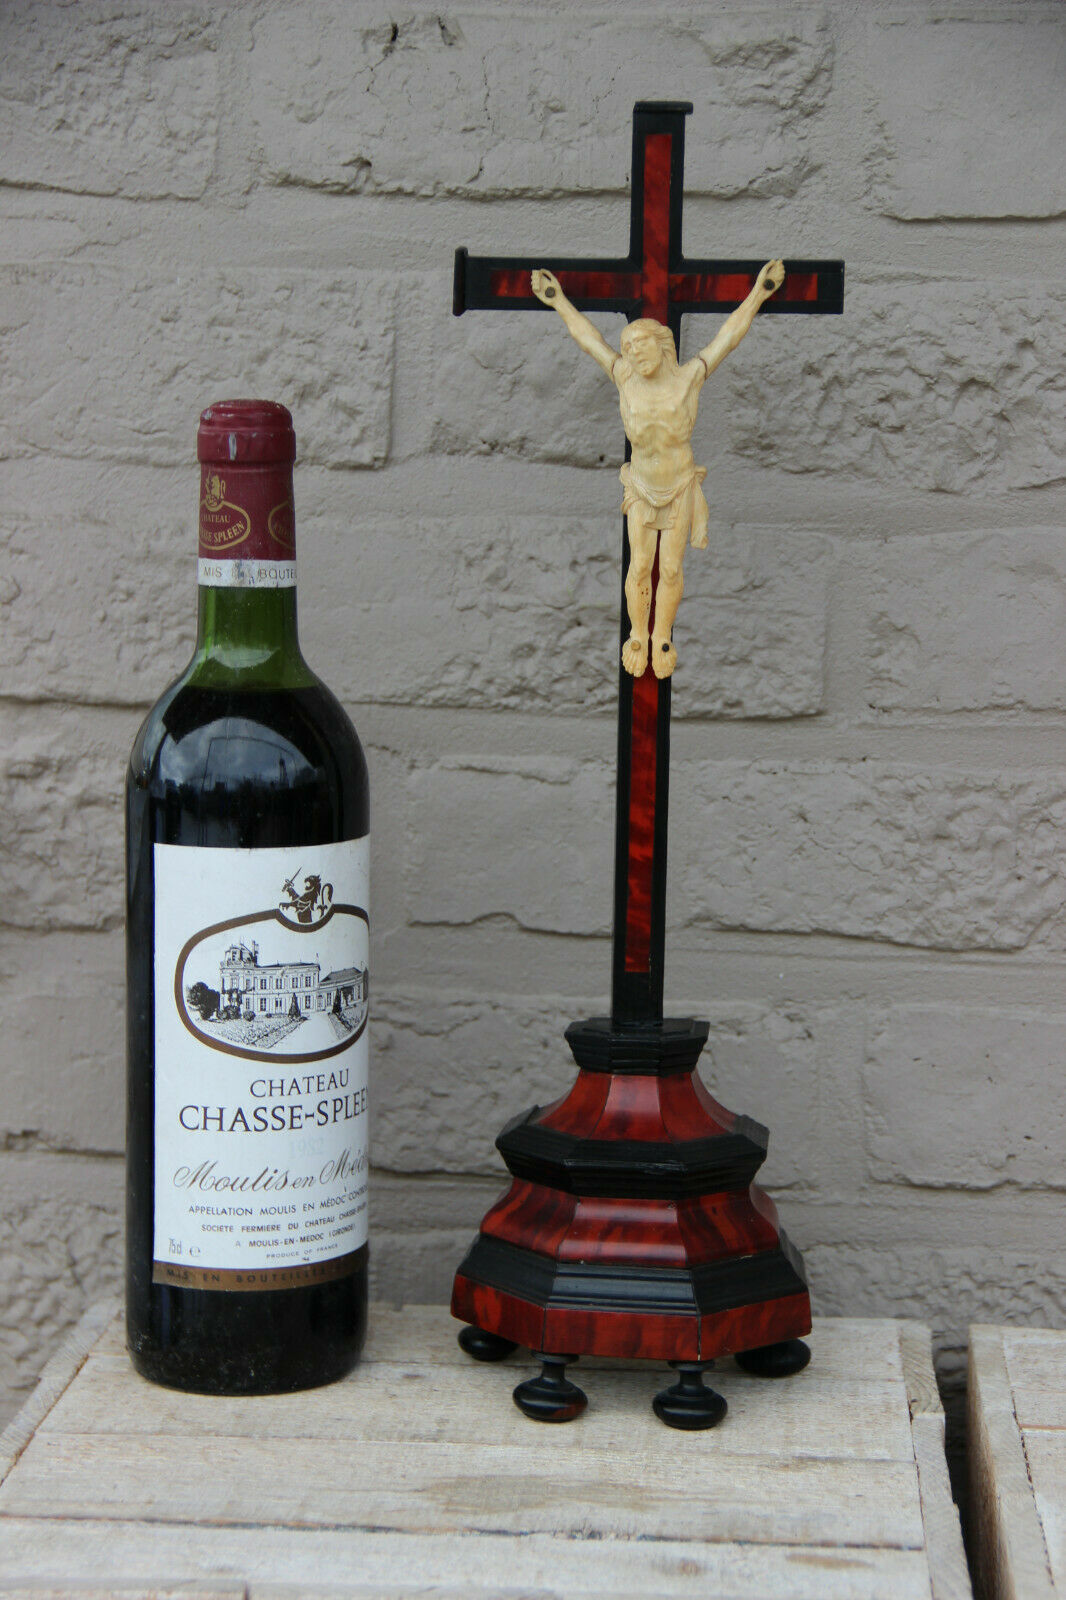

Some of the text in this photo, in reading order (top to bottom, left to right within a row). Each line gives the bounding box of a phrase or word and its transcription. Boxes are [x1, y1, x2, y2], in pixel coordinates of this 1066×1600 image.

[203, 566, 222, 578] MIS
[250, 1068, 349, 1098] CHATEAU
[173, 1160, 290, 1192] Moulis
[292, 1175, 317, 1190] en
[188, 1205, 253, 1216] APPELLATION
[259, 1204, 297, 1216] MOULIS
[302, 1202, 315, 1212] EN
[241, 1223, 281, 1233] FERMIERE
[287, 1222, 299, 1231] DU
[304, 1216, 335, 1229] CHATEAU
[266, 1251, 300, 1259] PRODUCE
[304, 1248, 313, 1256] OF
[316, 1243, 339, 1253] FRANCE
[166, 1267, 189, 1281] MIS
[203, 1270, 220, 1282] EN
